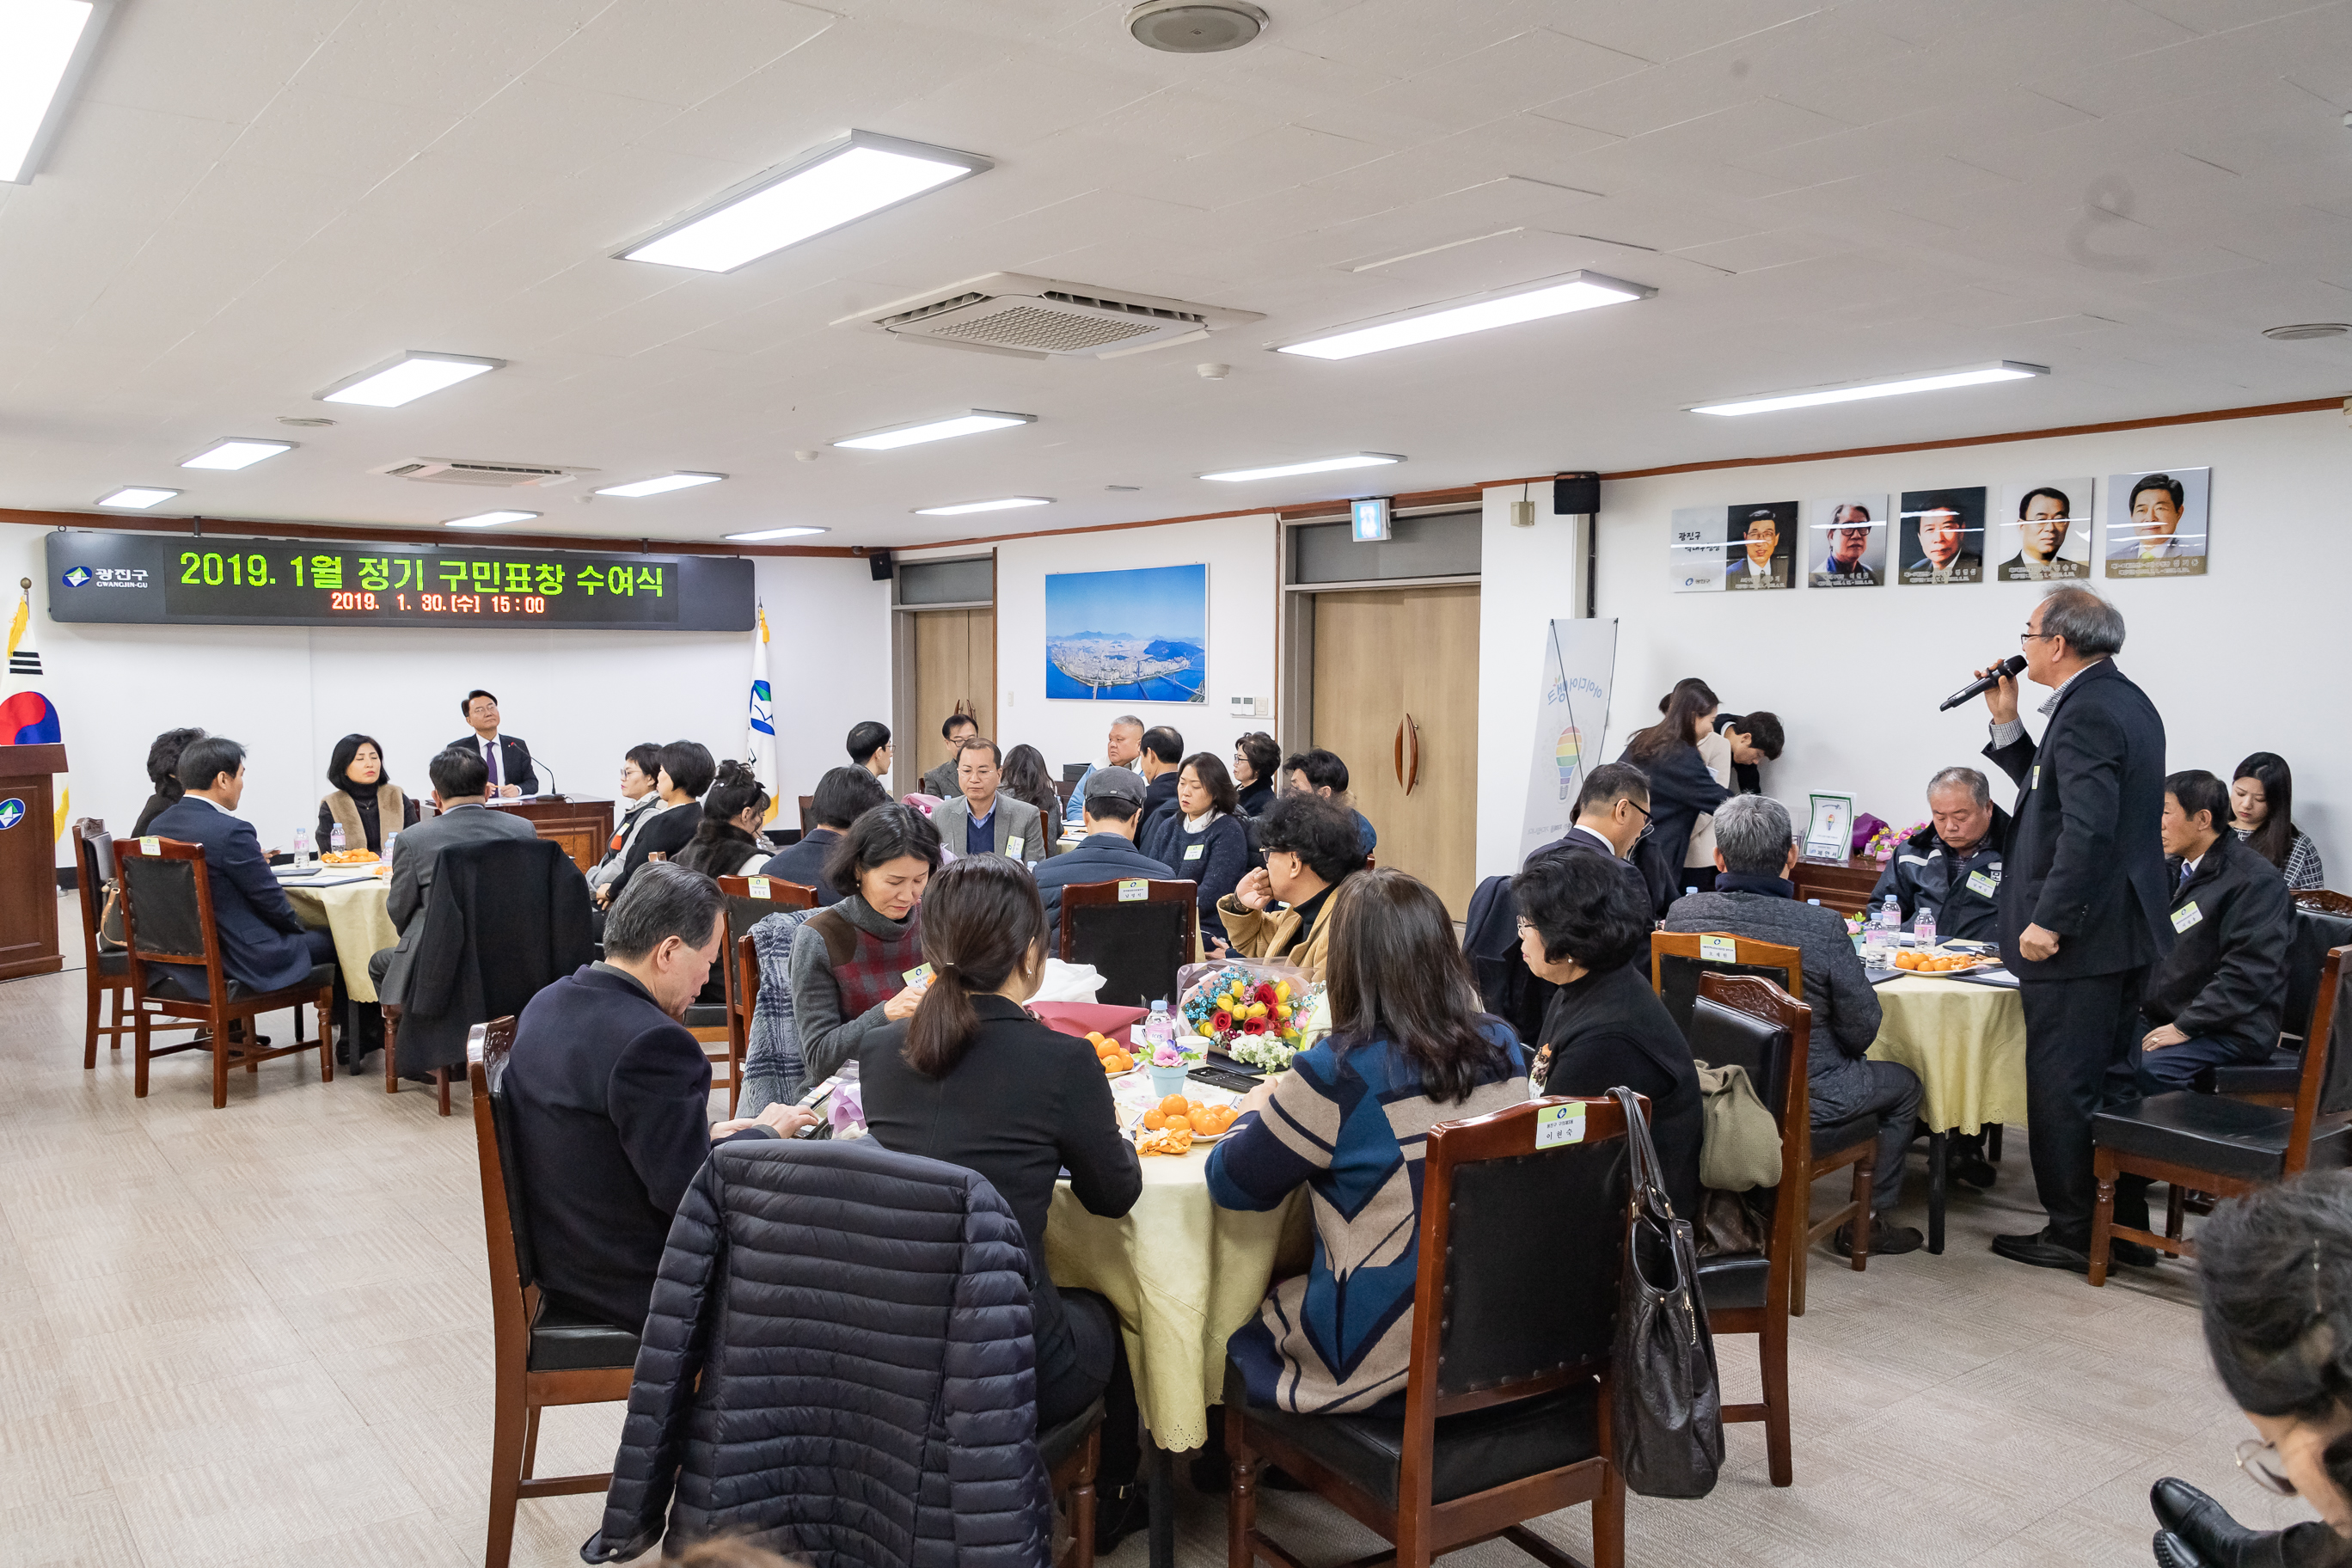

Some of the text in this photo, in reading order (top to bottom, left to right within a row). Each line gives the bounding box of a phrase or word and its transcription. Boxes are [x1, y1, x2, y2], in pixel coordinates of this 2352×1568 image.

[1678, 531, 1701, 541] 광진구
[95, 568, 149, 581] 광진구
[180, 551, 663, 597] 2019. 1월 정기 구민표창 수여식
[331, 591, 380, 610] 2019.
[395, 593, 412, 611] 1.
